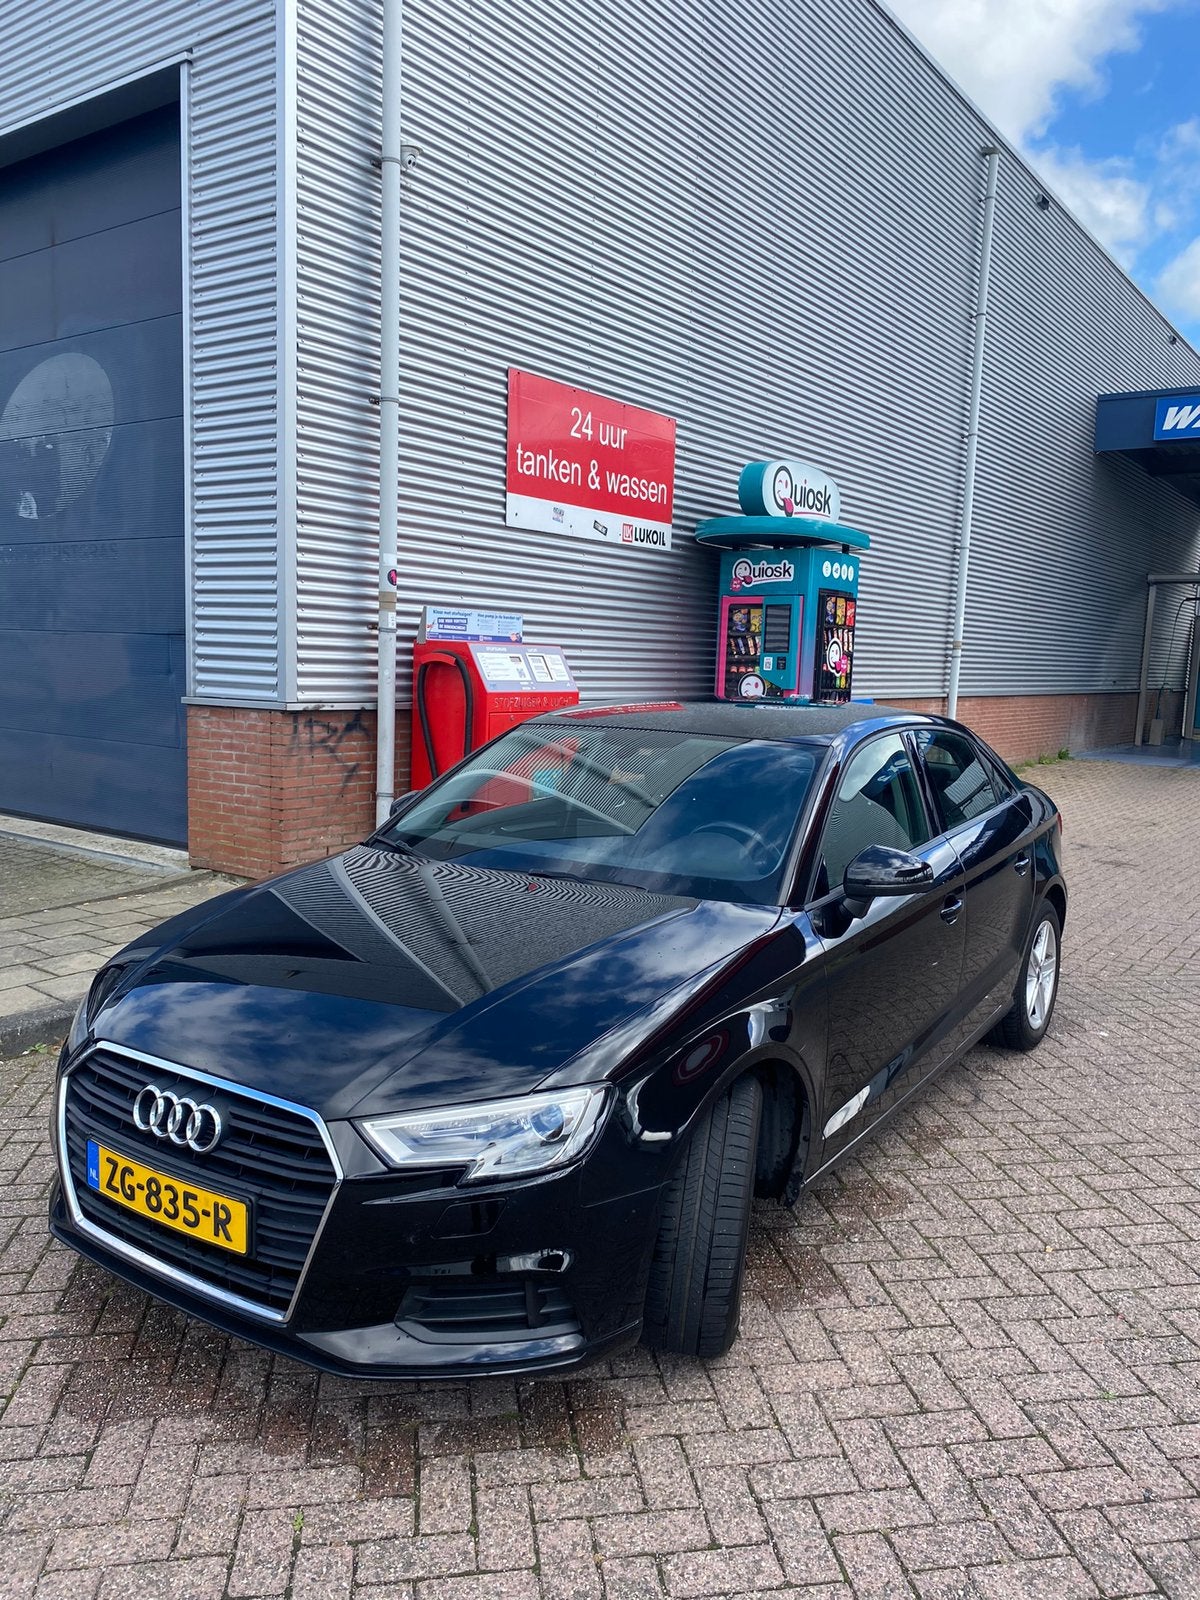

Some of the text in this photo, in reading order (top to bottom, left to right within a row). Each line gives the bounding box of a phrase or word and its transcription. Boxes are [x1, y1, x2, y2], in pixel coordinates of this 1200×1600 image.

[570, 406, 627, 450] 24 uur
[516, 442, 667, 505] tanken & wassen
[773, 465, 832, 516] Quiosk
[634, 527, 666, 546] LUKOIL
[734, 560, 792, 585] Quiosk
[494, 696, 573, 708] STOFZUIGER & LUCHT
[90, 1156, 233, 1242] NL ZG-835-R
